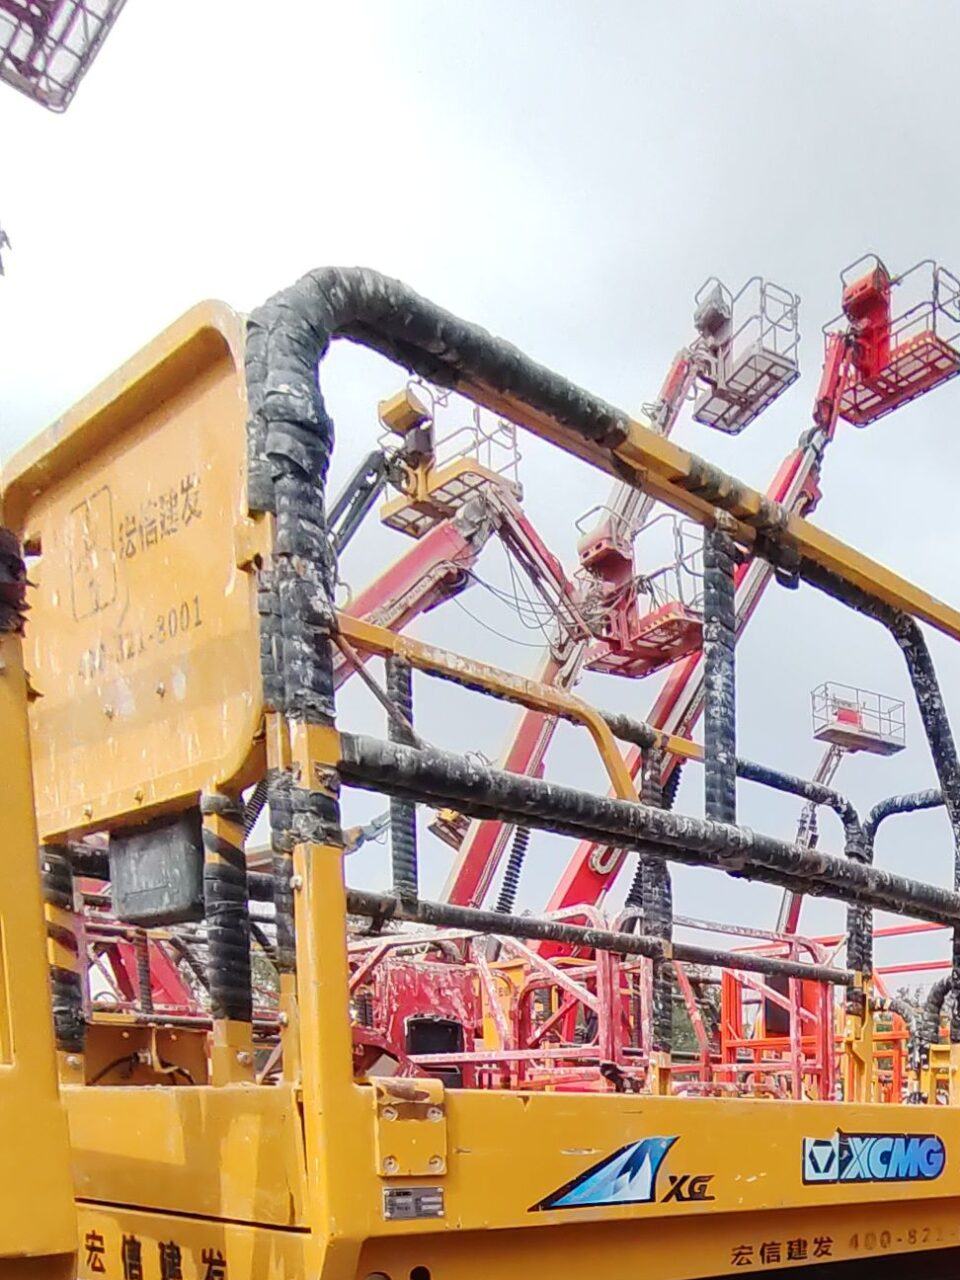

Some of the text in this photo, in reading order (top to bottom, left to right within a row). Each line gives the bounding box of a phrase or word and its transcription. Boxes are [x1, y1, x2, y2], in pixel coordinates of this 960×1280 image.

[840, 1137, 944, 1180] XCMG
[662, 1175, 715, 1203] XG
[730, 1236, 834, 1266] 宏信建发
